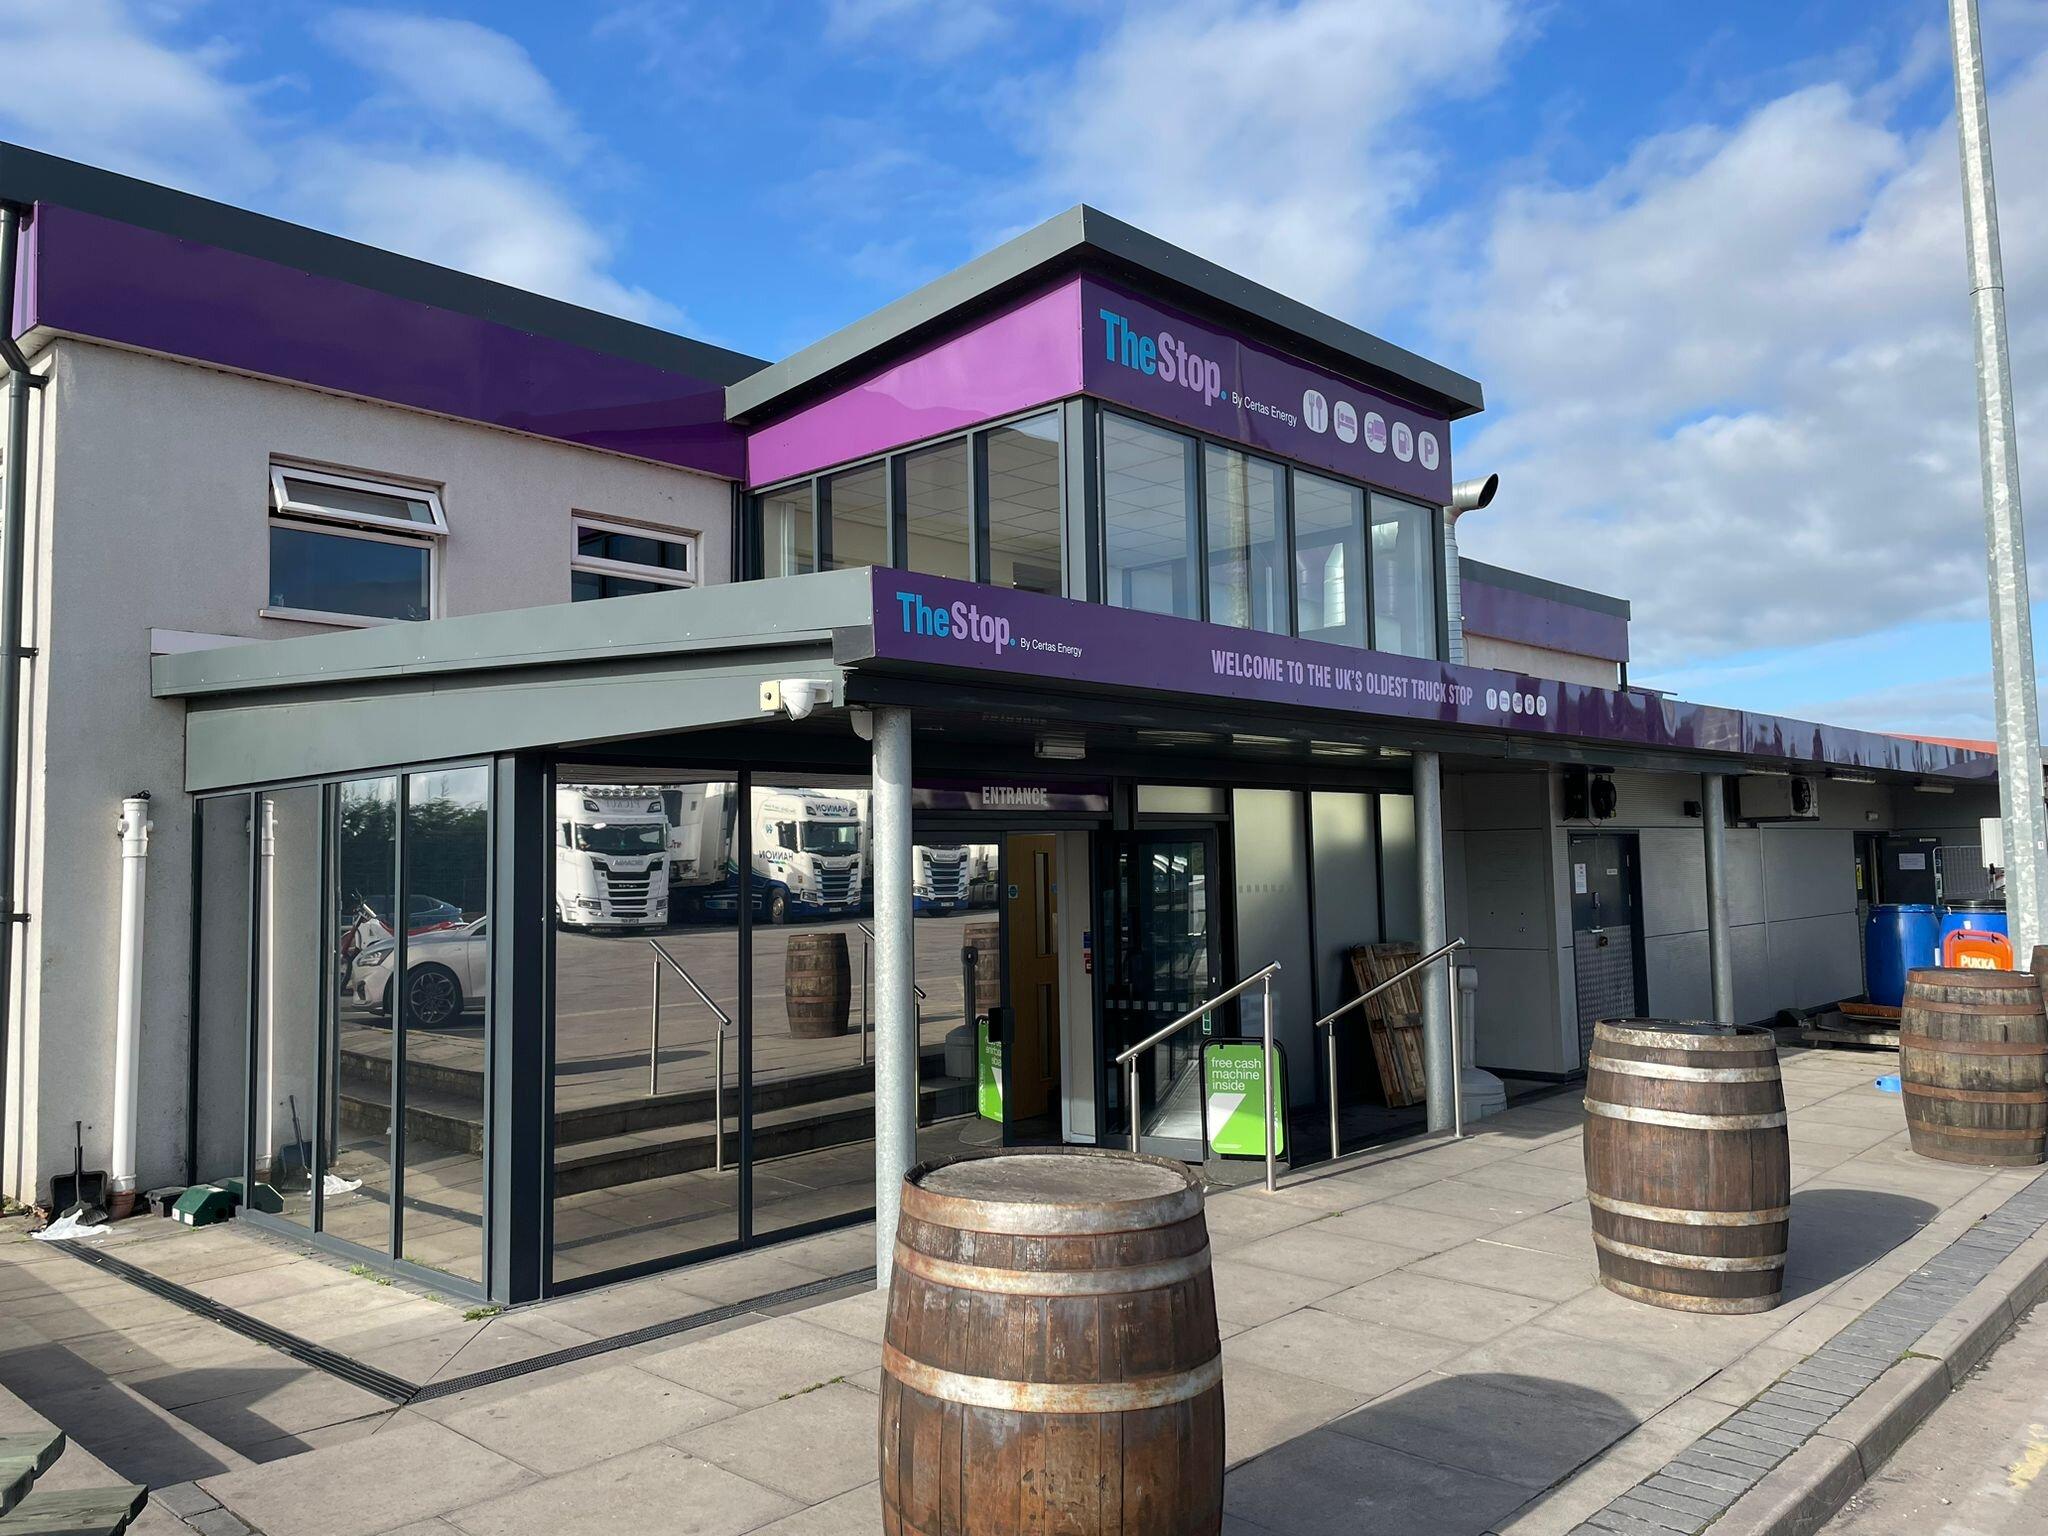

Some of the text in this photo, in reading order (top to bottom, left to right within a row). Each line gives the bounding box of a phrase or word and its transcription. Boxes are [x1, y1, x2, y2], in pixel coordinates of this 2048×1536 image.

[1231, 391, 1243, 407] By
[1244, 396, 1270, 417] Certas
[1270, 404, 1298, 427] Energy
[1020, 637, 1031, 651] By
[1032, 639, 1057, 653] Certas
[1057, 643, 1083, 658] Energy
[1211, 649, 1473, 706] WELCOME TO THE UK'S OLDEST TRUCK STOP
[982, 786, 1047, 806] ENTRANCE
[1960, 954, 1997, 970] PUKKA
[1211, 1056, 1262, 1069] free cash
[1212, 1069, 1260, 1080] machine
[1212, 1079, 1246, 1091] inside
